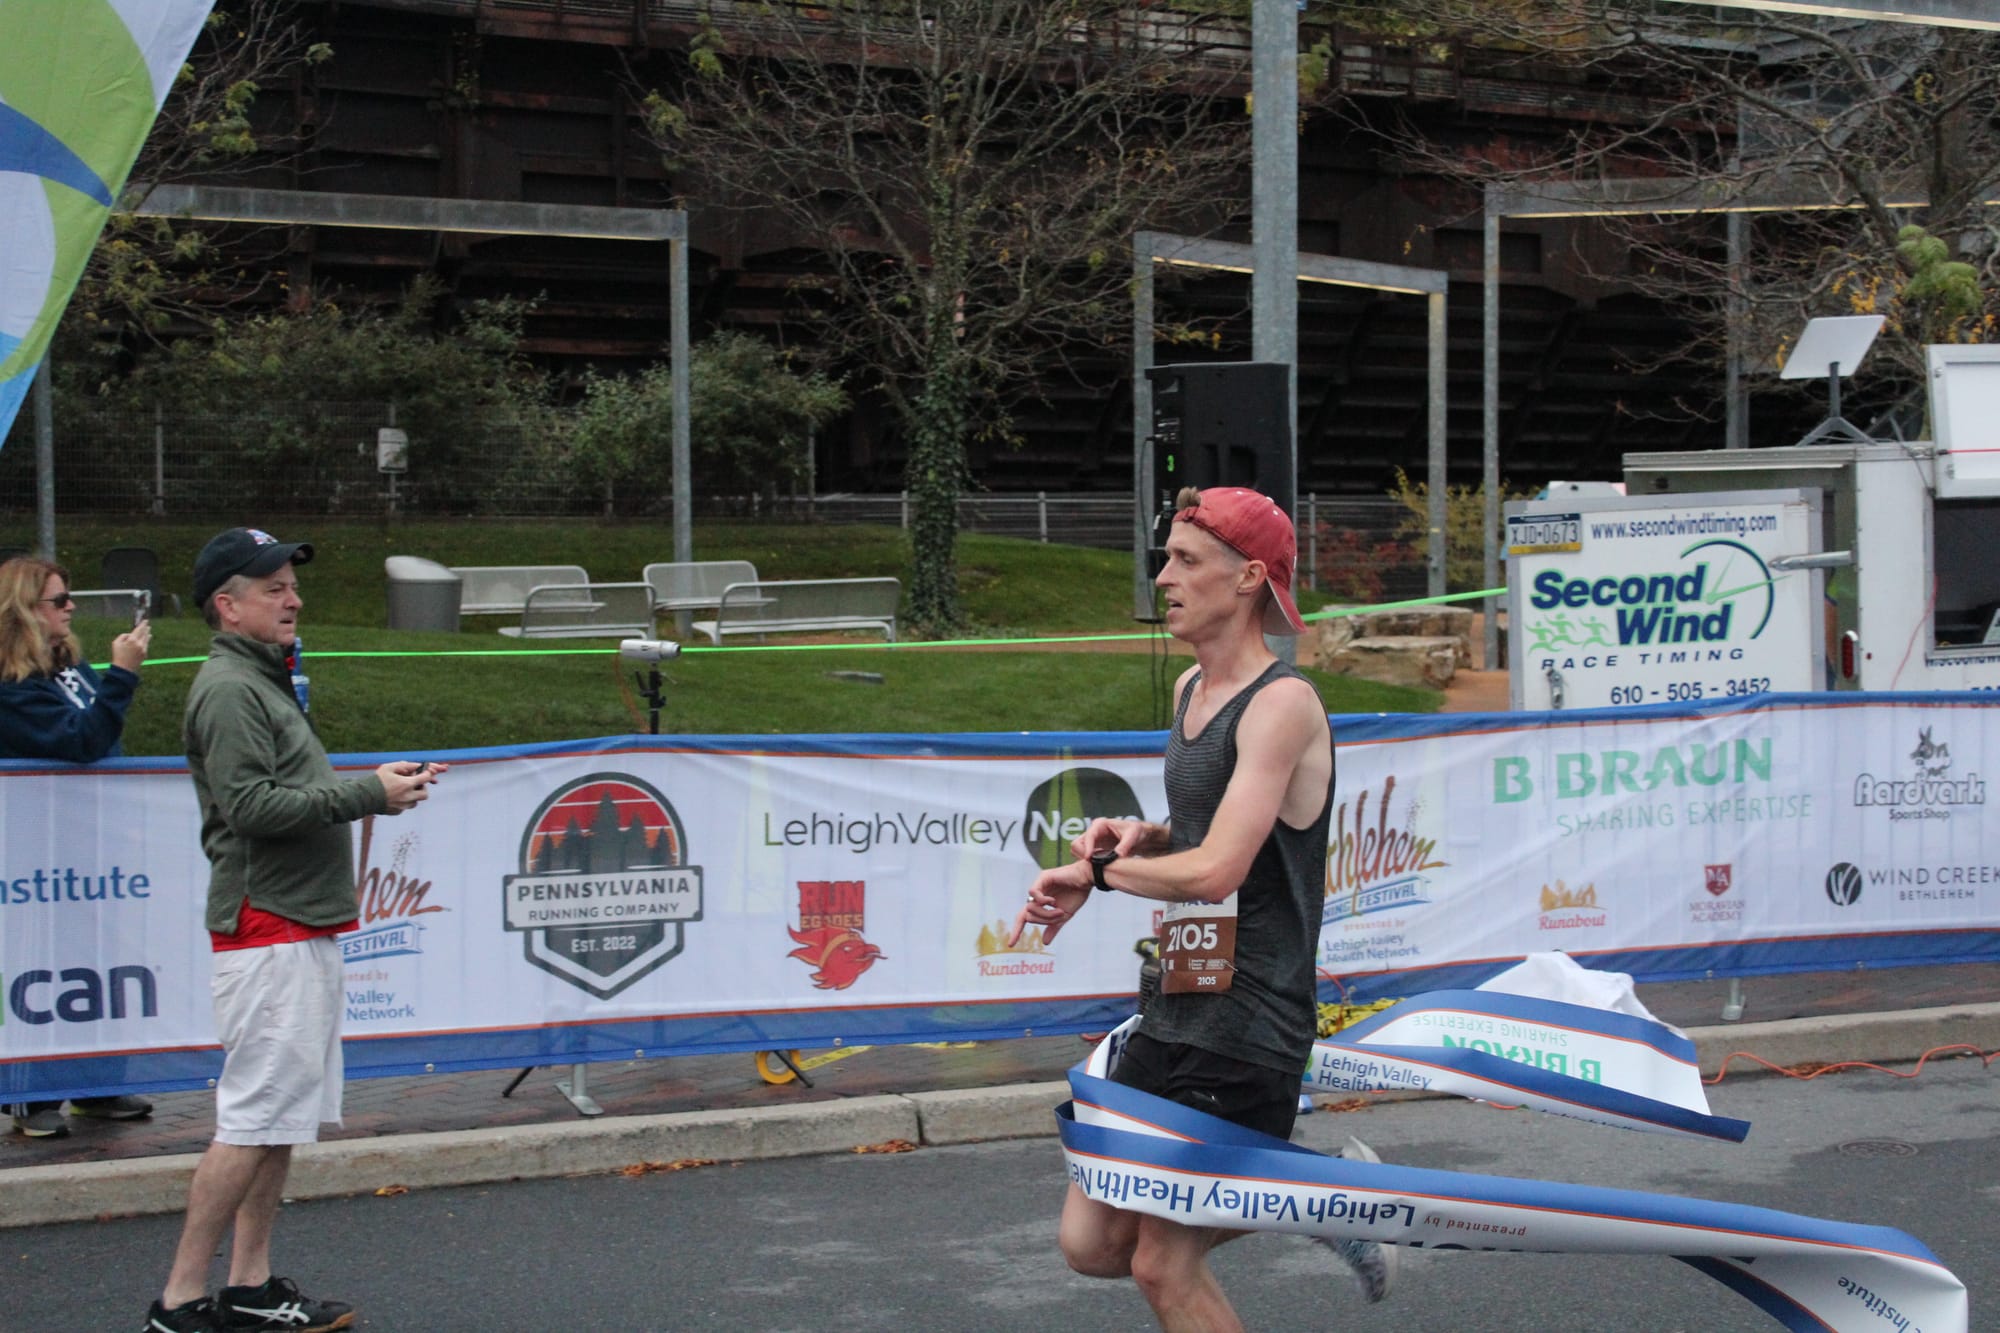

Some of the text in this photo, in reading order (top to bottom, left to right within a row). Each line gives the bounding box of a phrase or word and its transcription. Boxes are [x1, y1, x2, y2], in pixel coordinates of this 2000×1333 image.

[1591, 512, 1777, 540] www.secondwindtiming.com
[1531, 563, 1707, 609] Second
[1616, 604, 1733, 647] Wind
[1541, 648, 1745, 671] RACE TIMING
[1556, 738, 1772, 799] BRAUN
[1854, 773, 1986, 806] Aardvark
[1557, 794, 1813, 838] SHARING EXPERTISE
[764, 812, 1018, 854] LehighValley
[518, 877, 690, 902] PENNSYLVANIA
[1869, 868, 1930, 886] WIND
[797, 880, 865, 914] RUN
[1358, 883, 1417, 908] FESTIVAL
[1899, 889, 1975, 901] BETHLEHEM
[528, 902, 680, 921] RUNNING COMPANY
[1538, 914, 1606, 930] Runabout
[338, 930, 408, 955] ESTIVAL
[603, 936, 636, 952] 2022
[1166, 923, 1218, 952] 2105
[977, 960, 1055, 976] Runabout
[1197, 976, 1216, 986] 2105
[0, 965, 158, 1026] can
[346, 990, 395, 1006] Valley
[346, 1005, 416, 1021] Network
[1412, 1015, 1568, 1047] SHARING EXPERTISE
[1318, 1070, 1372, 1091] Health
[1322, 1053, 1432, 1090] Lehigh Valley
[1097, 1170, 1194, 1213] Health
[1203, 1181, 1299, 1222] Valley
[1307, 1193, 1416, 1227] Lehigh
[1423, 1215, 1527, 1236] presented by
[1837, 1276, 1911, 1333] Institute
